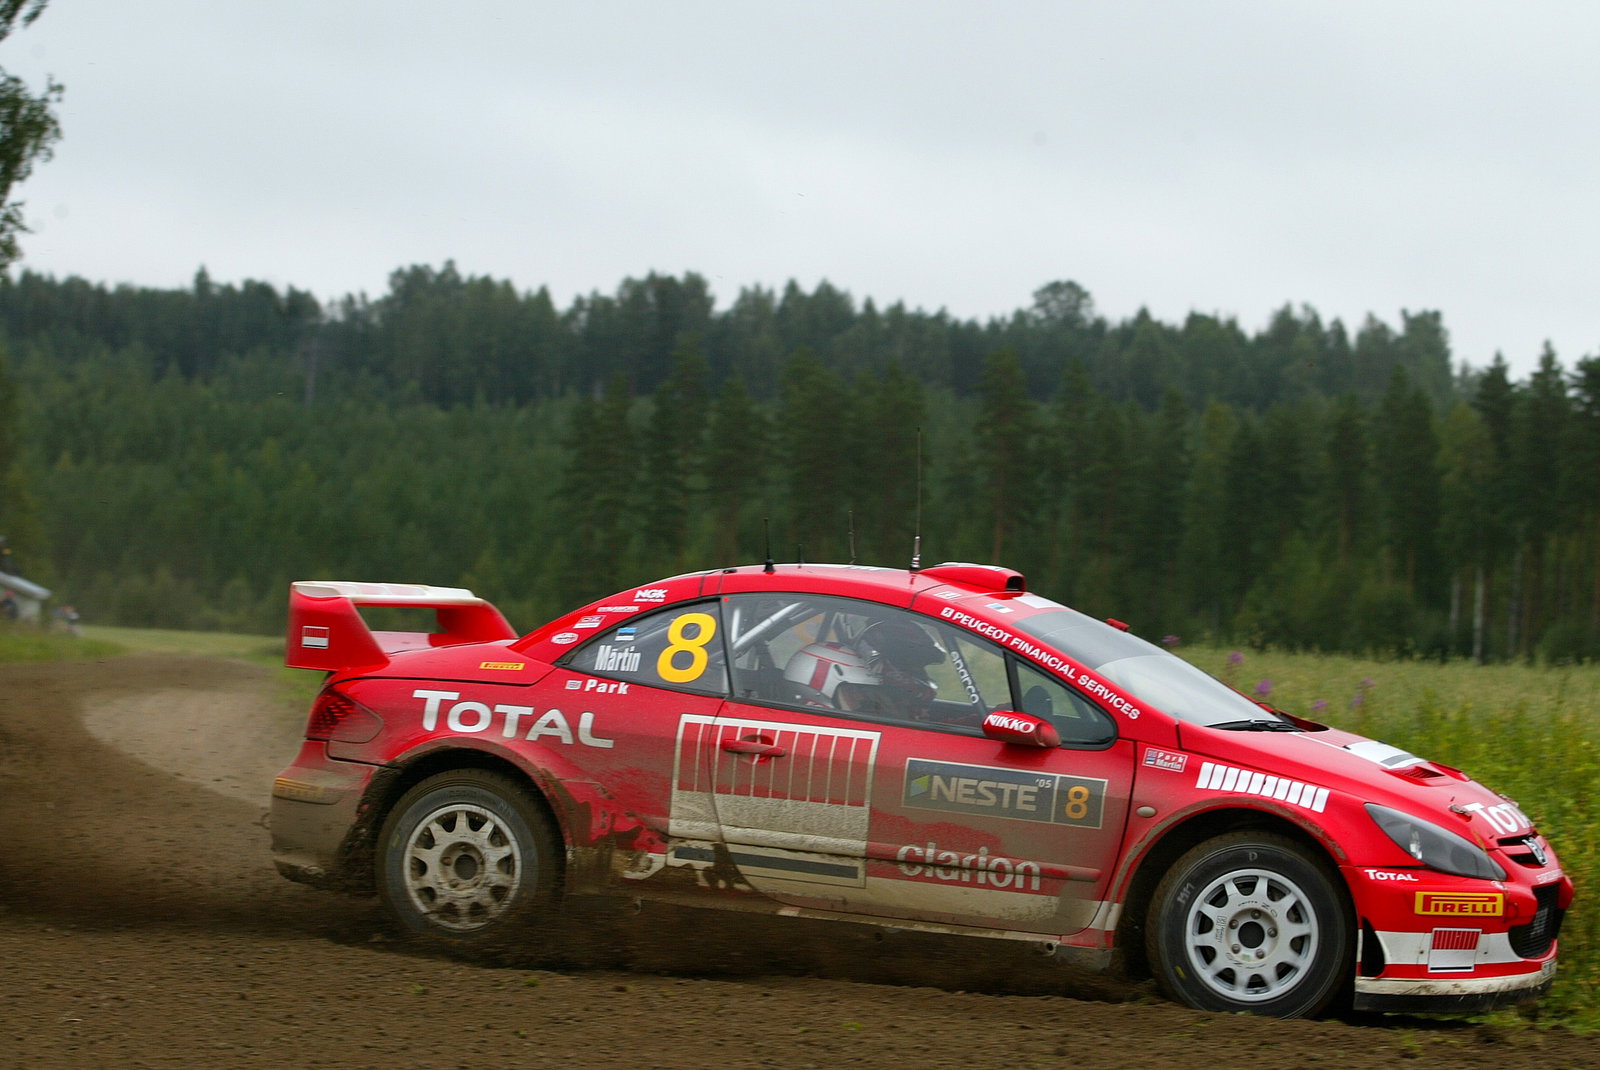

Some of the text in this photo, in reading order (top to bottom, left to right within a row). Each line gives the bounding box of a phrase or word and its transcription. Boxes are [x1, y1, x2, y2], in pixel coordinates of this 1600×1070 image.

[634, 589, 668, 599] NGK
[593, 645, 642, 672] Martin
[656, 612, 717, 683] 8
[952, 611, 1141, 720] PEUGEOT FINANCIAL SERVICES
[583, 679, 630, 695] Park
[412, 689, 614, 749] TOTAL
[984, 714, 1036, 734] NIKKO
[930, 775, 1038, 812] NESTE
[1064, 785, 1090, 819] 8
[1364, 869, 1420, 882] TOTAL
[1422, 894, 1498, 914] PIRELLI
